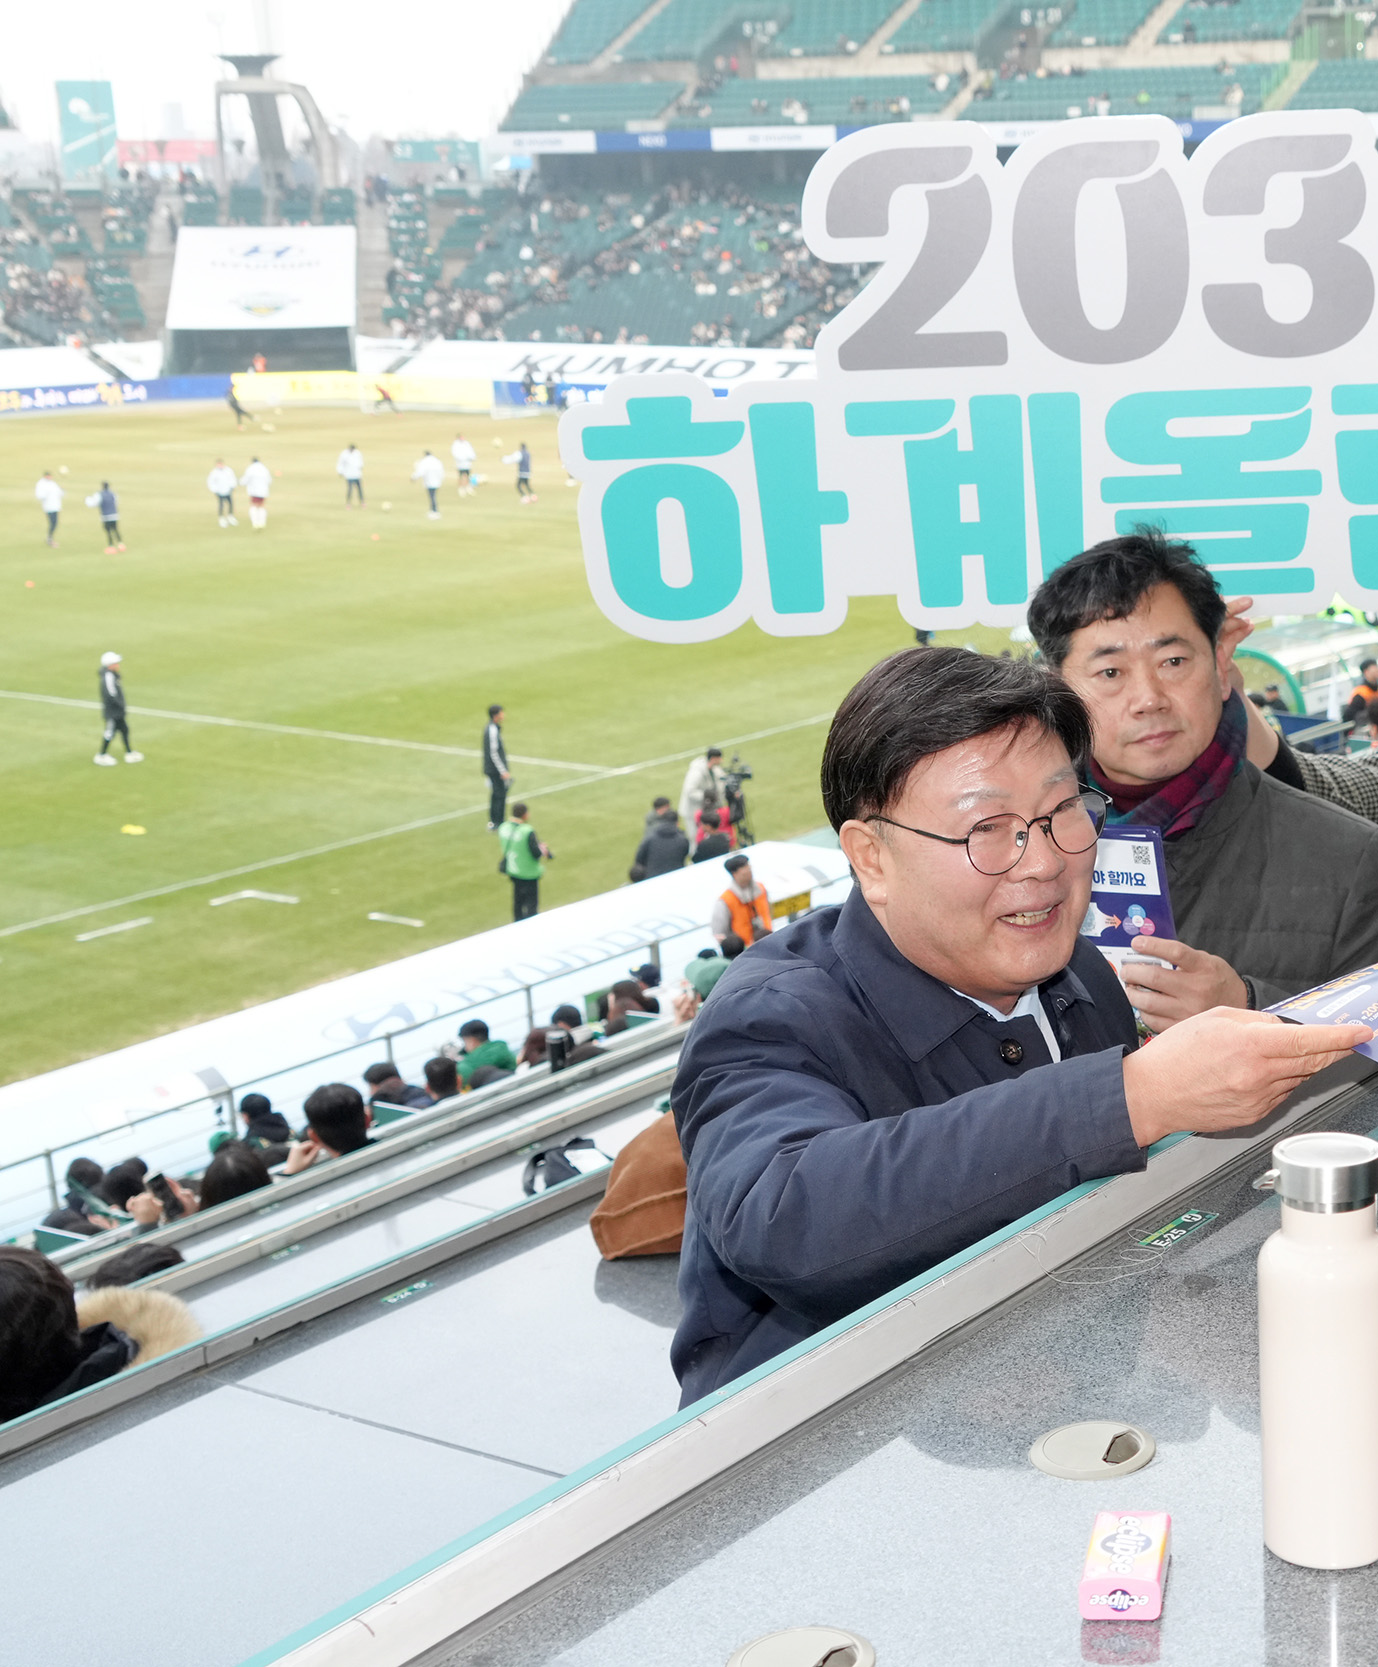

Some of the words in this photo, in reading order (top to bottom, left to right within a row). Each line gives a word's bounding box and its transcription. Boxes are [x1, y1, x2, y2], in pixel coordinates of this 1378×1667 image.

[510, 353, 757, 380] KUMHO
[1107, 870, 1147, 887] 할까요
[1151, 1228, 1187, 1248] E-25
[1107, 1515, 1147, 1575] eclipse
[1088, 1590, 1149, 1610] eclipse
